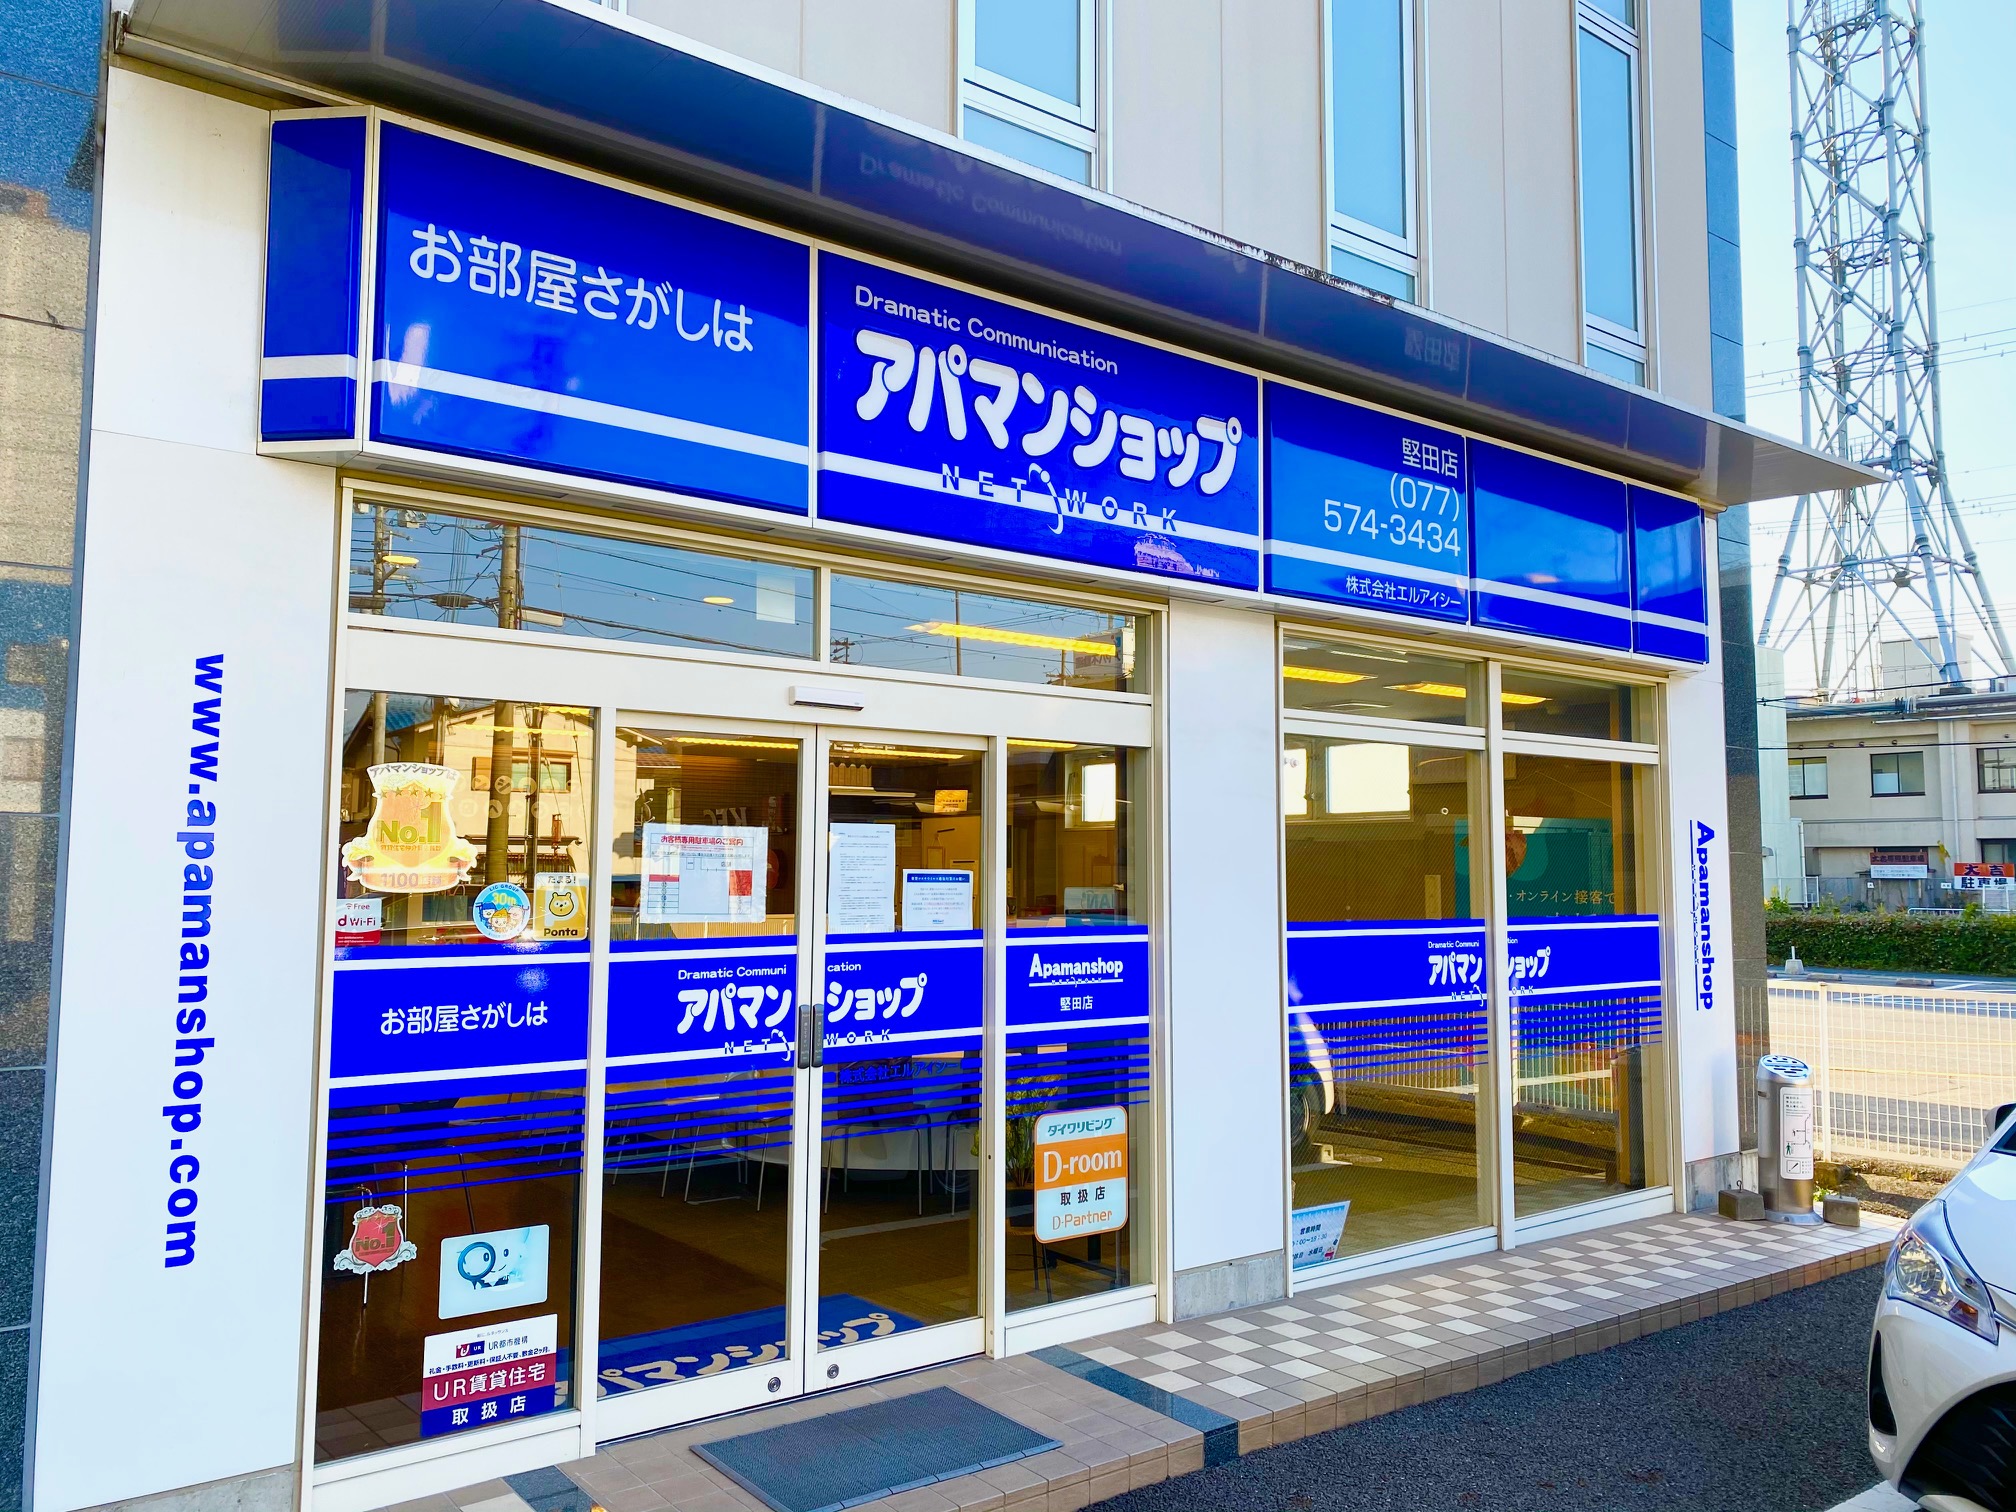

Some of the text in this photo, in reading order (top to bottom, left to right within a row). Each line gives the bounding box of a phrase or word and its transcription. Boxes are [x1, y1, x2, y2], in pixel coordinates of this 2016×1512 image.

[409, 223, 755, 353] お部屋さがしは
[855, 285, 1119, 375] Dramatic Communication
[855, 329, 1243, 495] アパマンショップ
[1402, 437, 1459, 478] 堅田店
[1389, 472, 1461, 521] (077)
[1324, 500, 1461, 557] 574-3434
[1346, 575, 1462, 609] 株式会社エルアイシー
[376, 801, 442, 843] No.1
[350, 917, 376, 926] Wi-Fi
[543, 928, 578, 937] Ponta
[1696, 820, 1715, 1010] Apamanshop
[163, 654, 224, 1270] www.apamanshop.com
[677, 962, 861, 980] Dramatic Communi cation
[1029, 953, 1124, 979] Apamanshop
[1428, 951, 1483, 986] アパマン
[676, 982, 792, 1034] アパマン
[827, 972, 928, 1023] ショップ
[1060, 995, 1093, 1011] 堅田店
[1511, 985, 1534, 995] ORK
[380, 1000, 548, 1035] お部屋さがしは
[839, 1061, 959, 1084] 株式会社エルアイシー
[1047, 1117, 1116, 1137] ダイワリビング
[1043, 1148, 1122, 1184] D-room
[1060, 1186, 1106, 1206] 取扱店
[355, 1221, 396, 1252] No.1
[1052, 1209, 1113, 1231] D-Partner
[488, 1335, 528, 1350] UR都市機構
[434, 1362, 546, 1401] UR賃貸住宅
